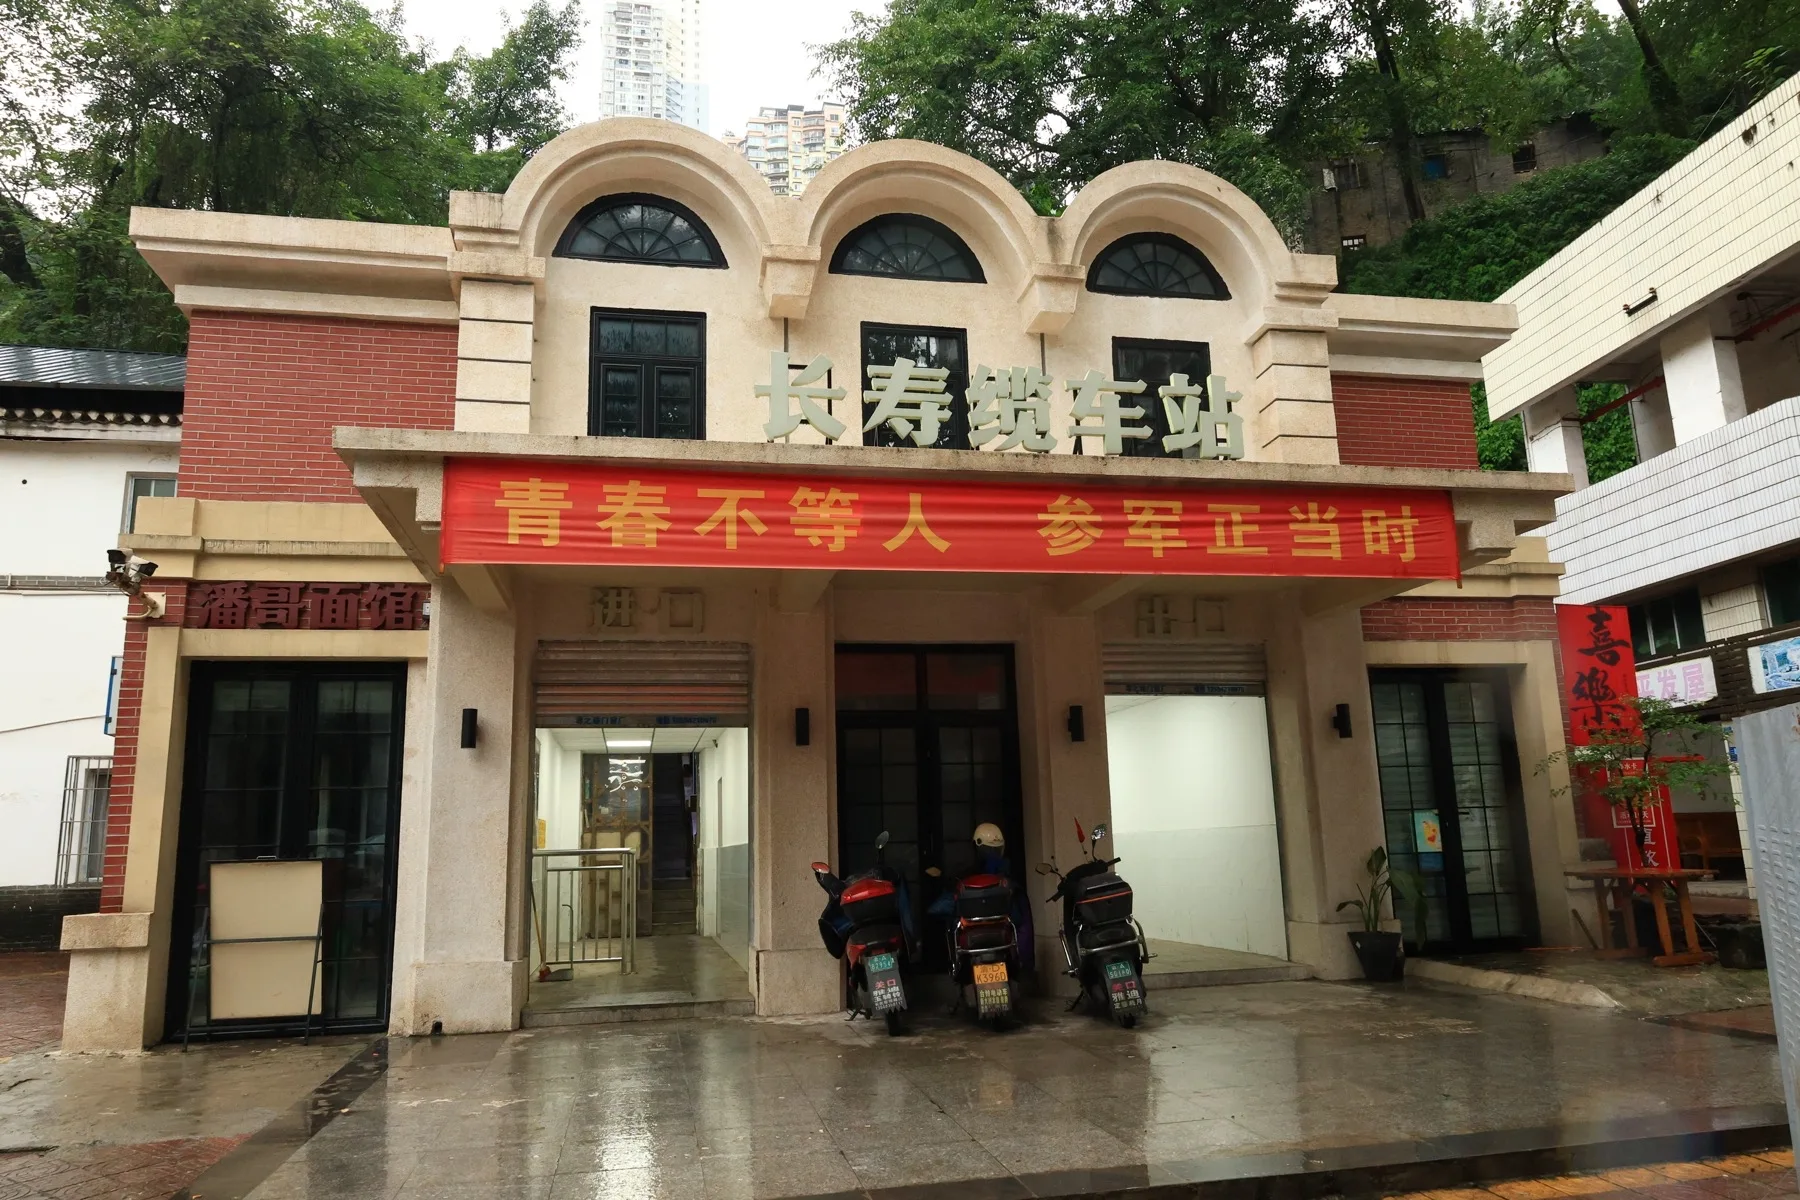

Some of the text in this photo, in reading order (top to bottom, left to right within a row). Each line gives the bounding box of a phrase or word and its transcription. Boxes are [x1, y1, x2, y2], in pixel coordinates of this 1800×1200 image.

[754, 351, 1245, 459] 长寿缆车站
[494, 477, 1419, 563] 青春不等人 参军正当时
[195, 582, 422, 629] 潘哥面馆
[589, 587, 704, 633] 进口
